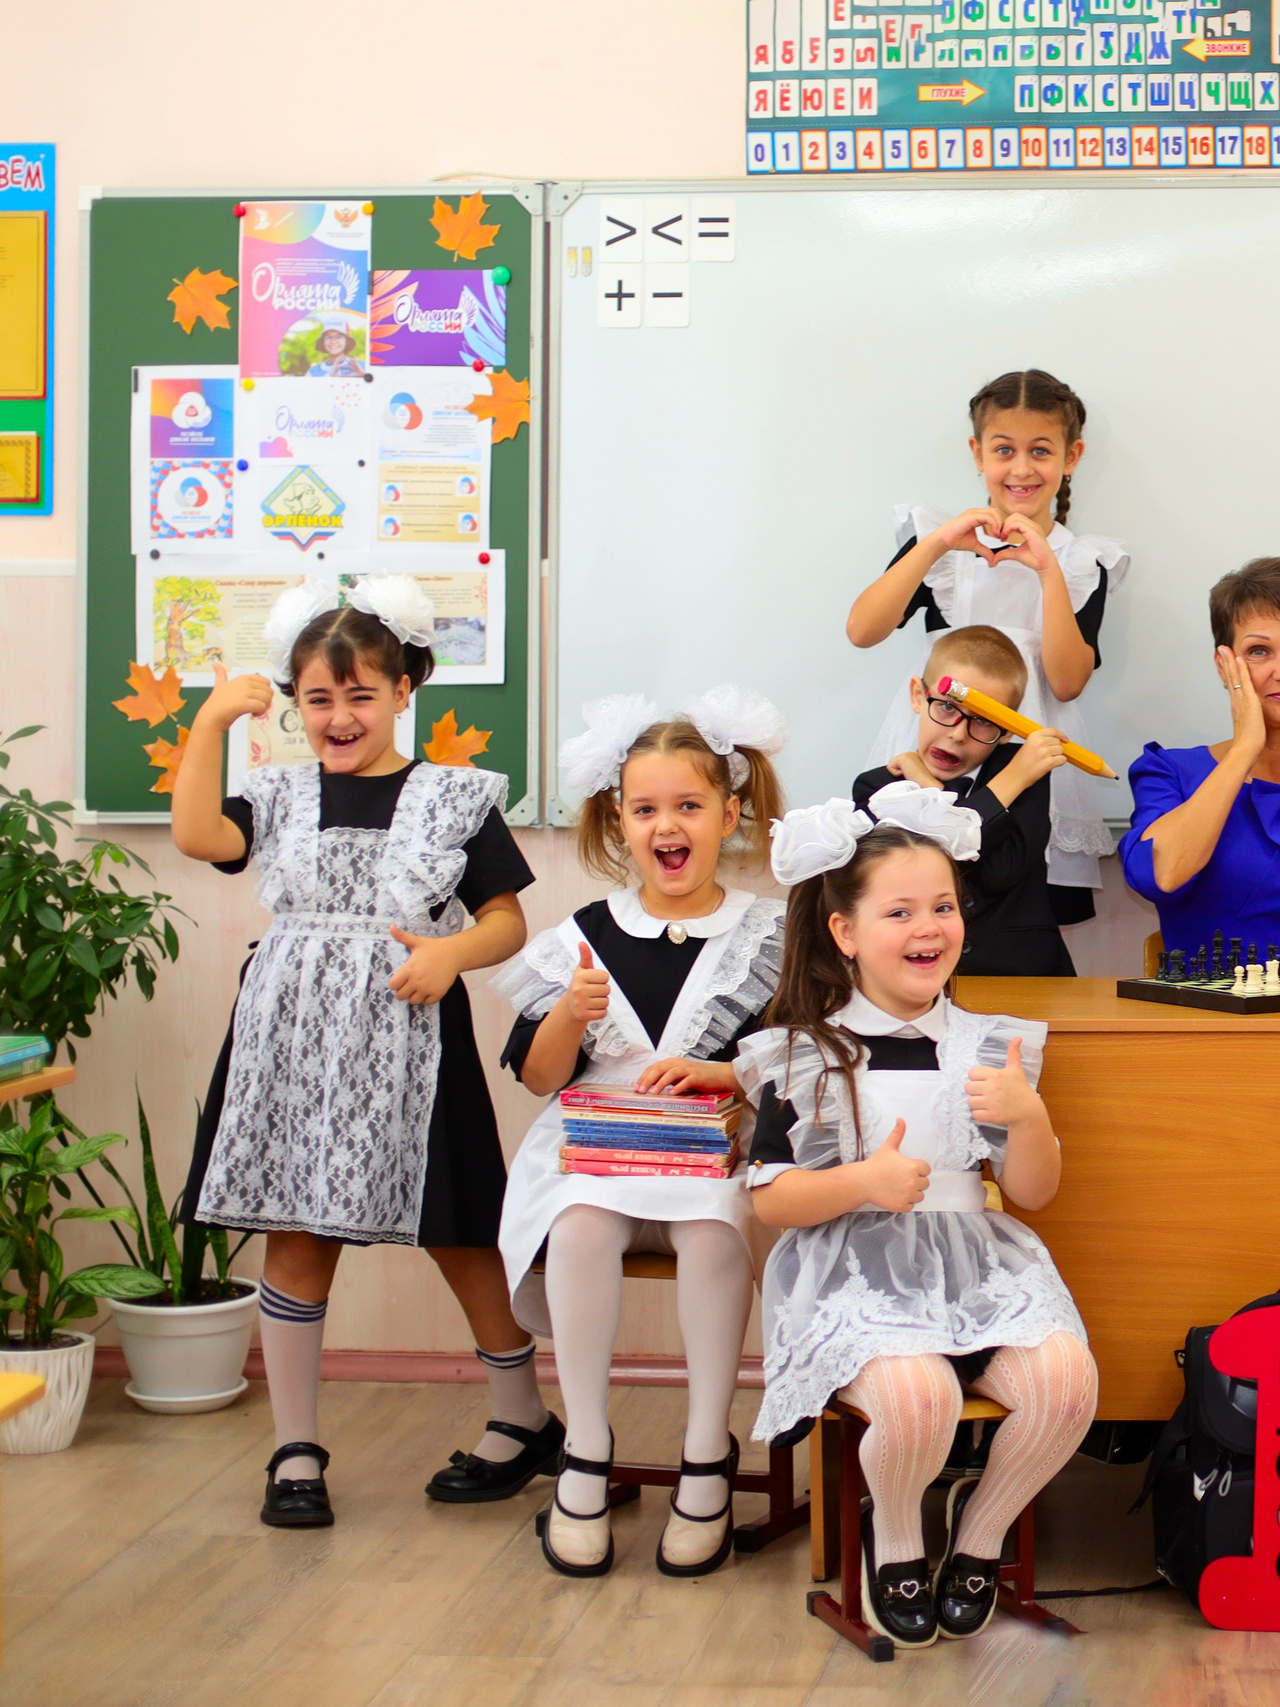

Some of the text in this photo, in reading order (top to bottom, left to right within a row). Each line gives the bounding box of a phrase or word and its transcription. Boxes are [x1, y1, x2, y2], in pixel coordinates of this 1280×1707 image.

[1205, 43, 1247, 53] ЗВОНКИЕ
[754, 83, 872, 111] Я Ё Ю Е И
[931, 88, 966, 98] ГЛУХИЕ
[1020, 81, 1274, 109] П Ф К С Т Ш Ц Ч Щ Х
[754, 143, 765, 162] 0
[782, 142, 790, 161] 1
[808, 142, 820, 160] 2
[836, 141, 847, 160] 3
[863, 141, 874, 159] 4
[891, 140, 902, 159] 5
[917, 140, 928, 159] 6
[945, 139, 956, 158] 7
[973, 139, 983, 158] 8
[1000, 138, 1011, 158] 9
[1022, 138, 1042, 157] 10
[1053, 138, 1071, 157] 11
[1079, 137, 1100, 157] 12
[1106, 137, 1127, 156] 13
[1135, 136, 1155, 155] 14
[1162, 136, 1182, 155] 15
[1190, 136, 1210, 155] 16
[1218, 136, 1239, 154] 17
[1246, 136, 1265, 154] 18
[252, 262, 341, 309] Орлята
[262, 514, 343, 528] ОРЛЕНОК
